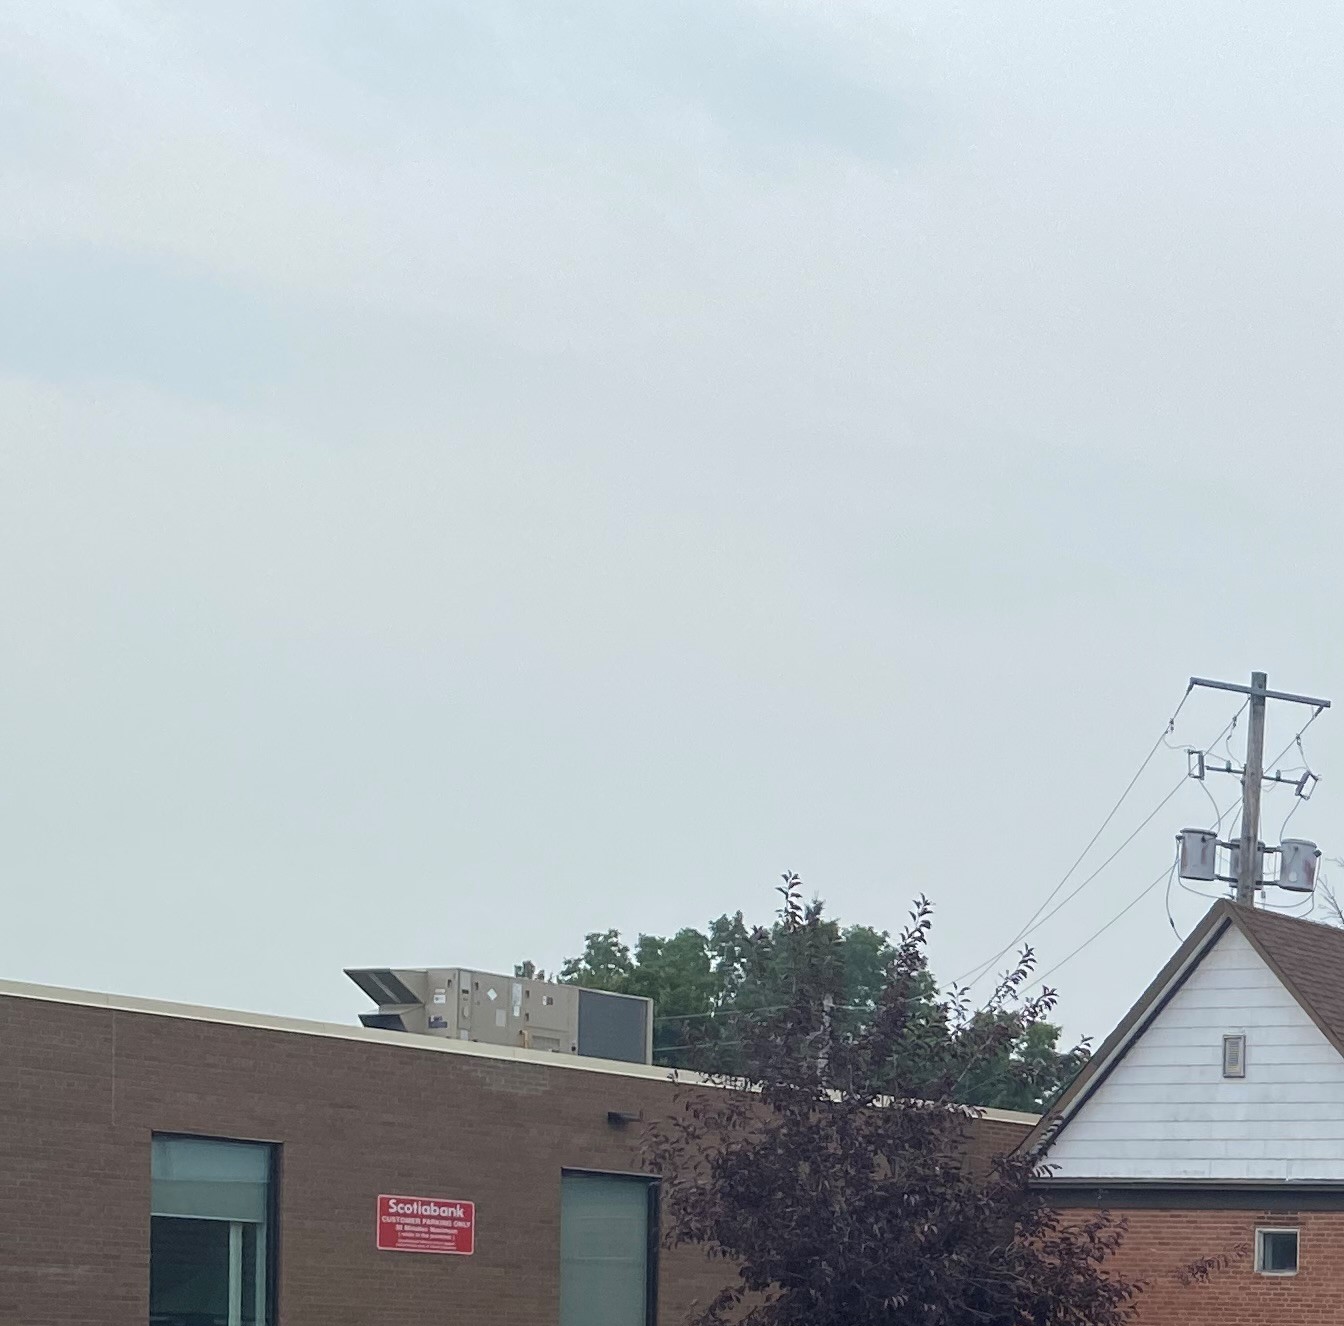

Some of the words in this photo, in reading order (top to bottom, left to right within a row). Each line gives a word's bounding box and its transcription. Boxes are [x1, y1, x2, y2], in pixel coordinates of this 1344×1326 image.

[388, 1199, 464, 1218] Scotiabank
[381, 1215, 421, 1224] CUSTOMER
[422, 1218, 453, 1227] PARKING
[453, 1220, 471, 1228] ONLY
